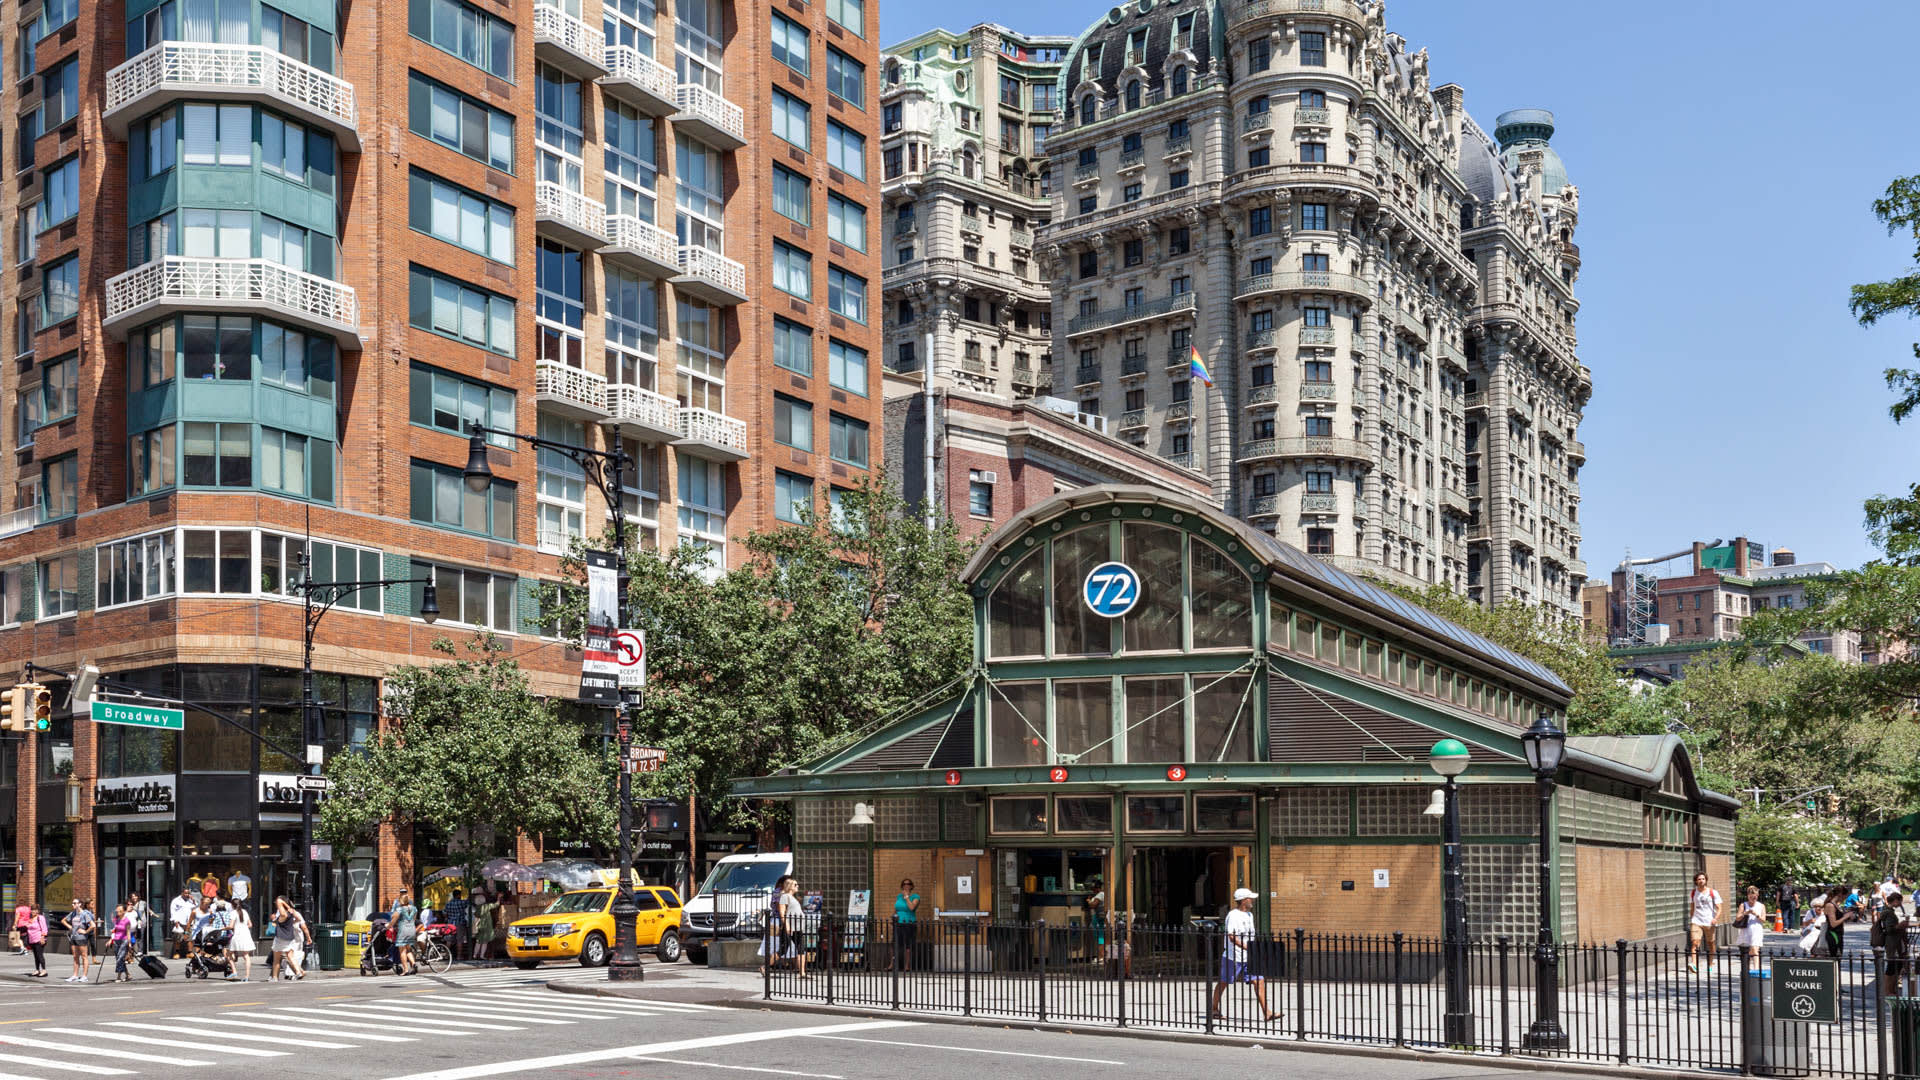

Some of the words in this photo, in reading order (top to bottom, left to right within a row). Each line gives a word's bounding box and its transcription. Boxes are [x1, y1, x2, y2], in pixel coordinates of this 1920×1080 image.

[1091, 573, 1133, 607] 72
[588, 638, 602, 648] JULY
[602, 640, 611, 649] 24
[105, 707, 168, 726] Broadway
[630, 747, 666, 761] BROADWAY
[631, 761, 638, 772] W
[640, 760, 648, 771] 72
[649, 759, 658, 770] ST
[949, 772, 956, 783] 1
[1055, 770, 1063, 780] 2
[1172, 768, 1181, 778] 3
[1789, 968, 1818, 977] VERDI
[1785, 981, 1823, 990] SQUARE
